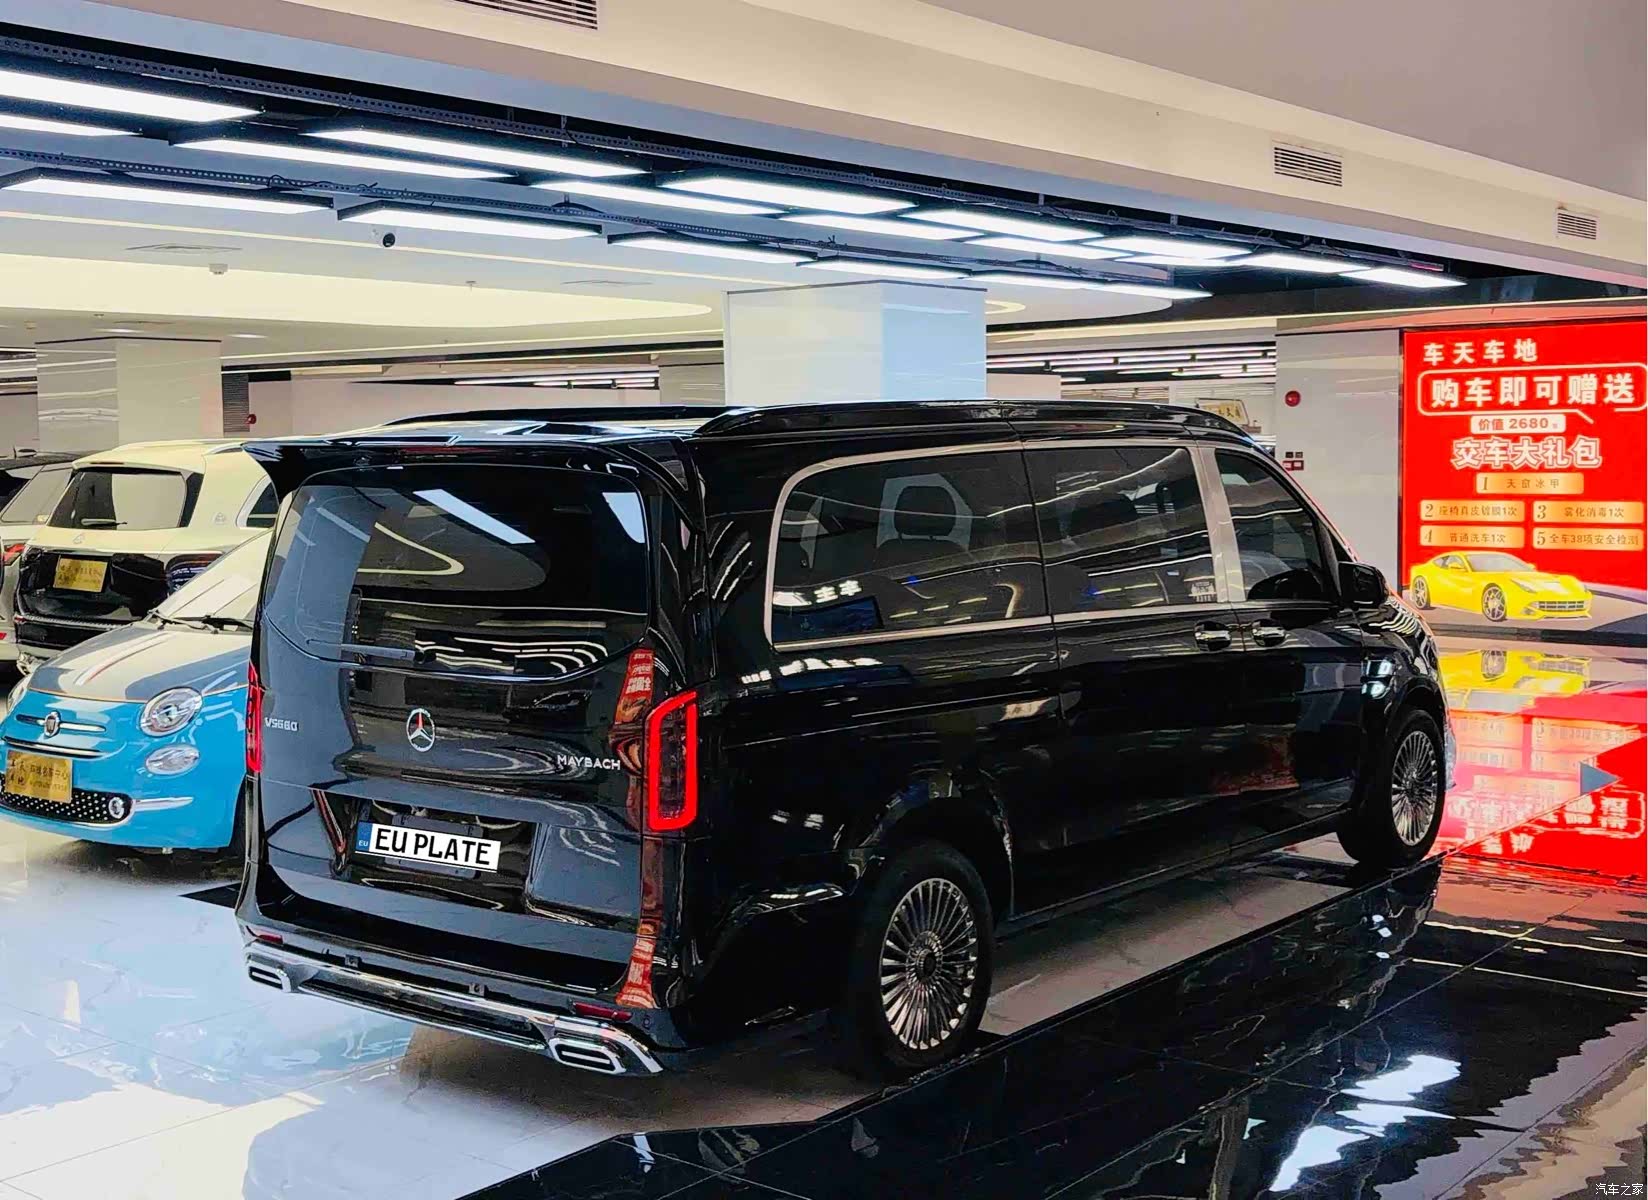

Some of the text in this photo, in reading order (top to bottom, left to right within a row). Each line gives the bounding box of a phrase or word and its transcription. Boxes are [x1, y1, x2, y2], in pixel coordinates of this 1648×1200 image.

[1423, 338, 1538, 365] 车天车地
[1431, 372, 1635, 408] 购车即可赠送
[1451, 434, 1602, 470] 交车大礼包
[557, 754, 621, 771] MAYBACH
[358, 839, 369, 847] EU
[375, 828, 492, 865] EU PLATE
